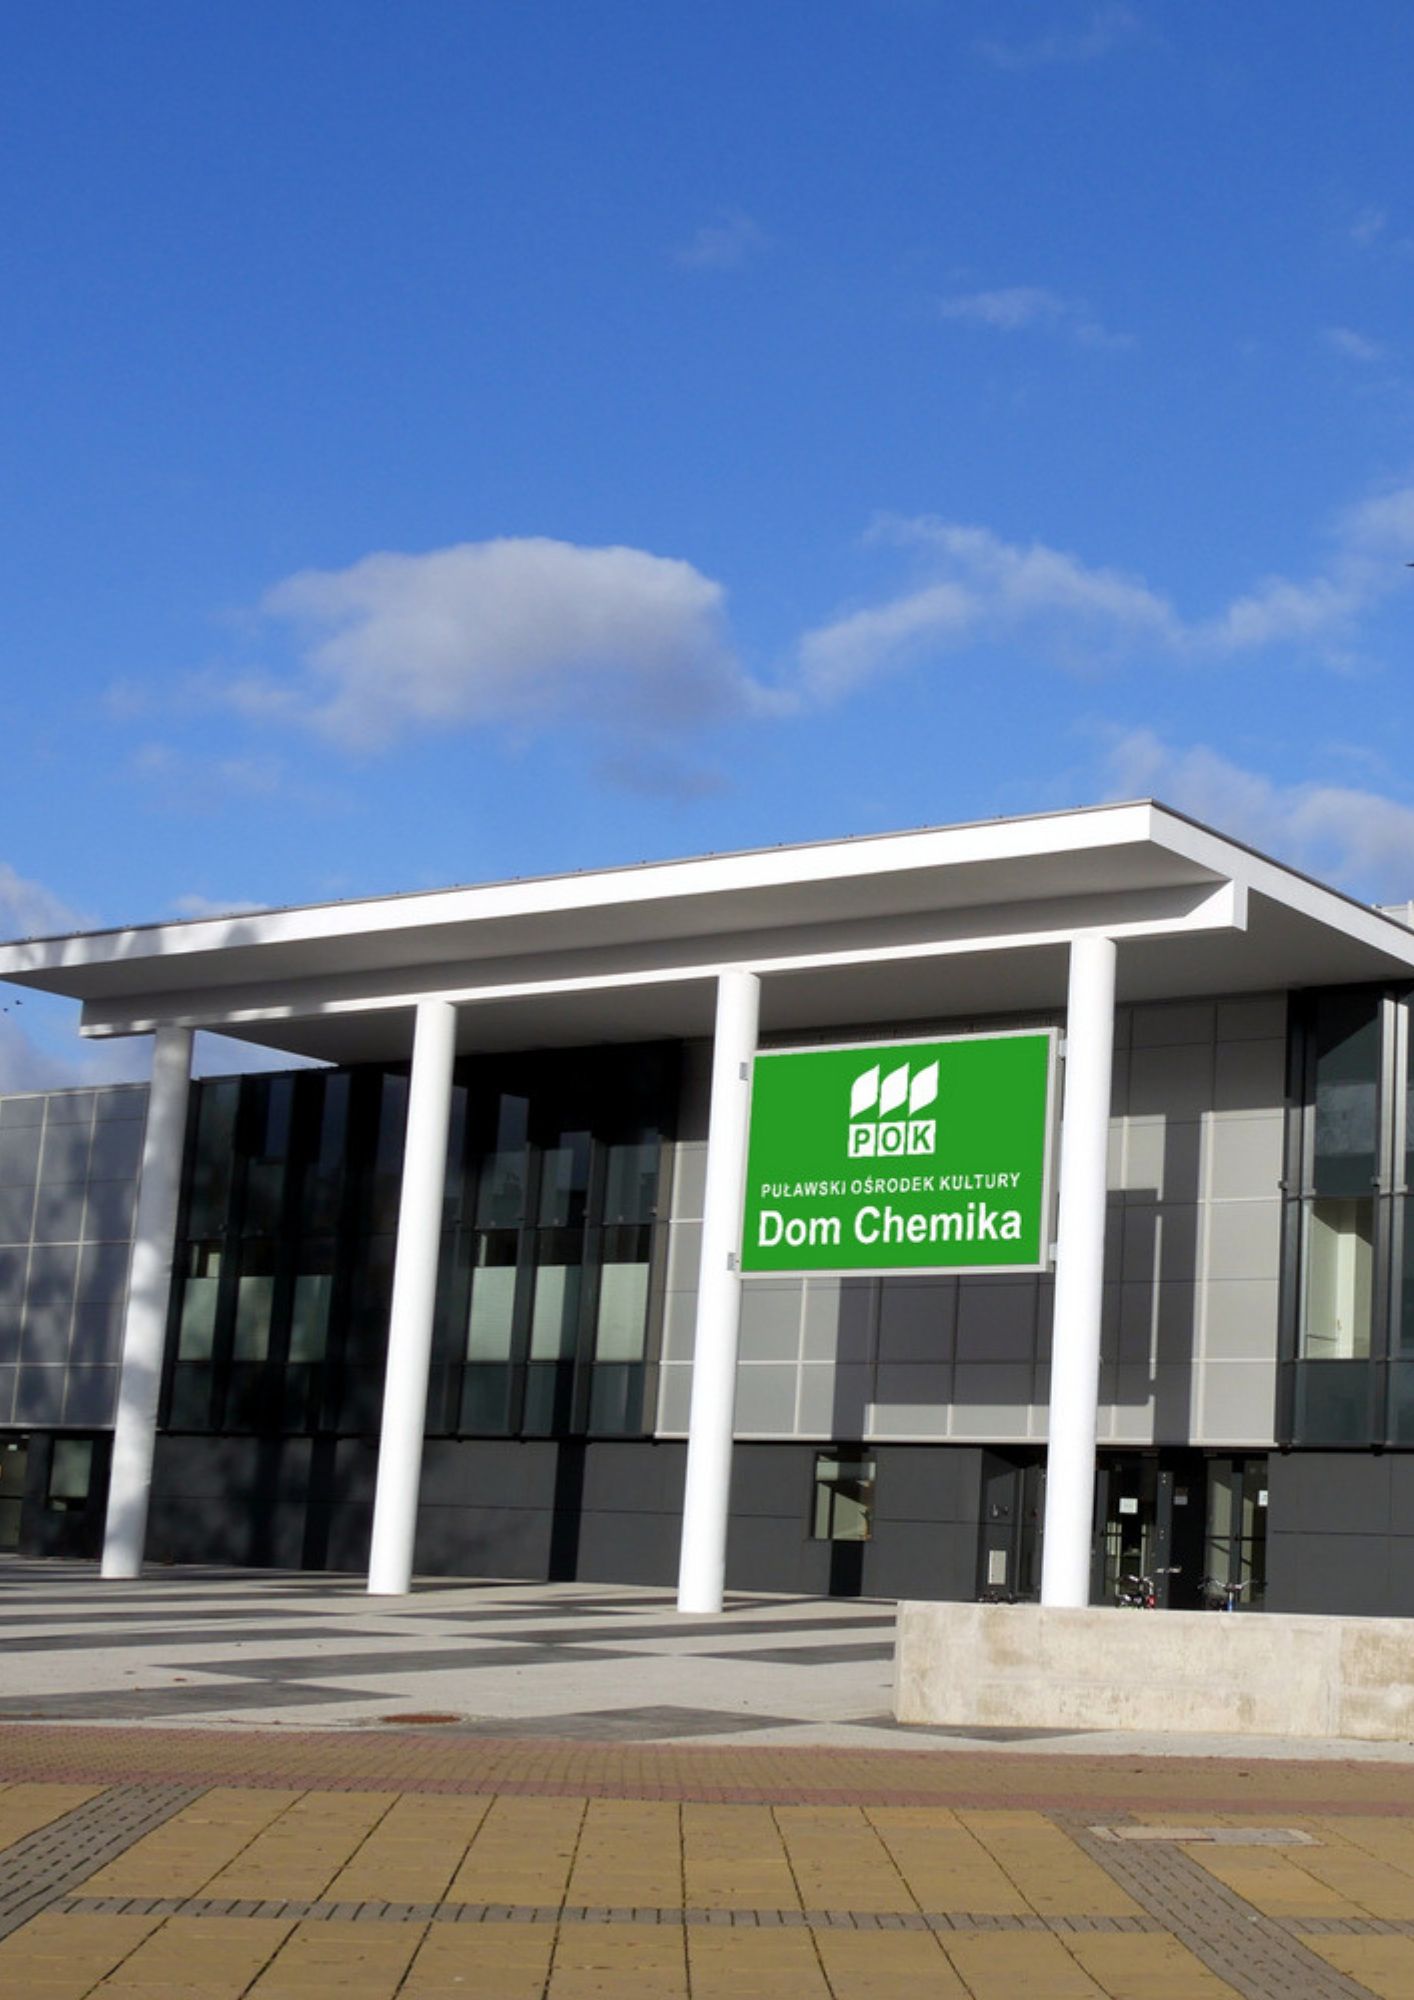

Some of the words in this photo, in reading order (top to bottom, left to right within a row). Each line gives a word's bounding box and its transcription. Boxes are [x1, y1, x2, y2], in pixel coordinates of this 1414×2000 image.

[854, 1124, 931, 1154] POK
[761, 1180, 846, 1198] PUŁAWSKI
[850, 1176, 934, 1195] OŚRODEK
[939, 1172, 1020, 1191] KULTURY
[758, 1210, 842, 1247] Dom
[854, 1201, 1022, 1245] Chemika
